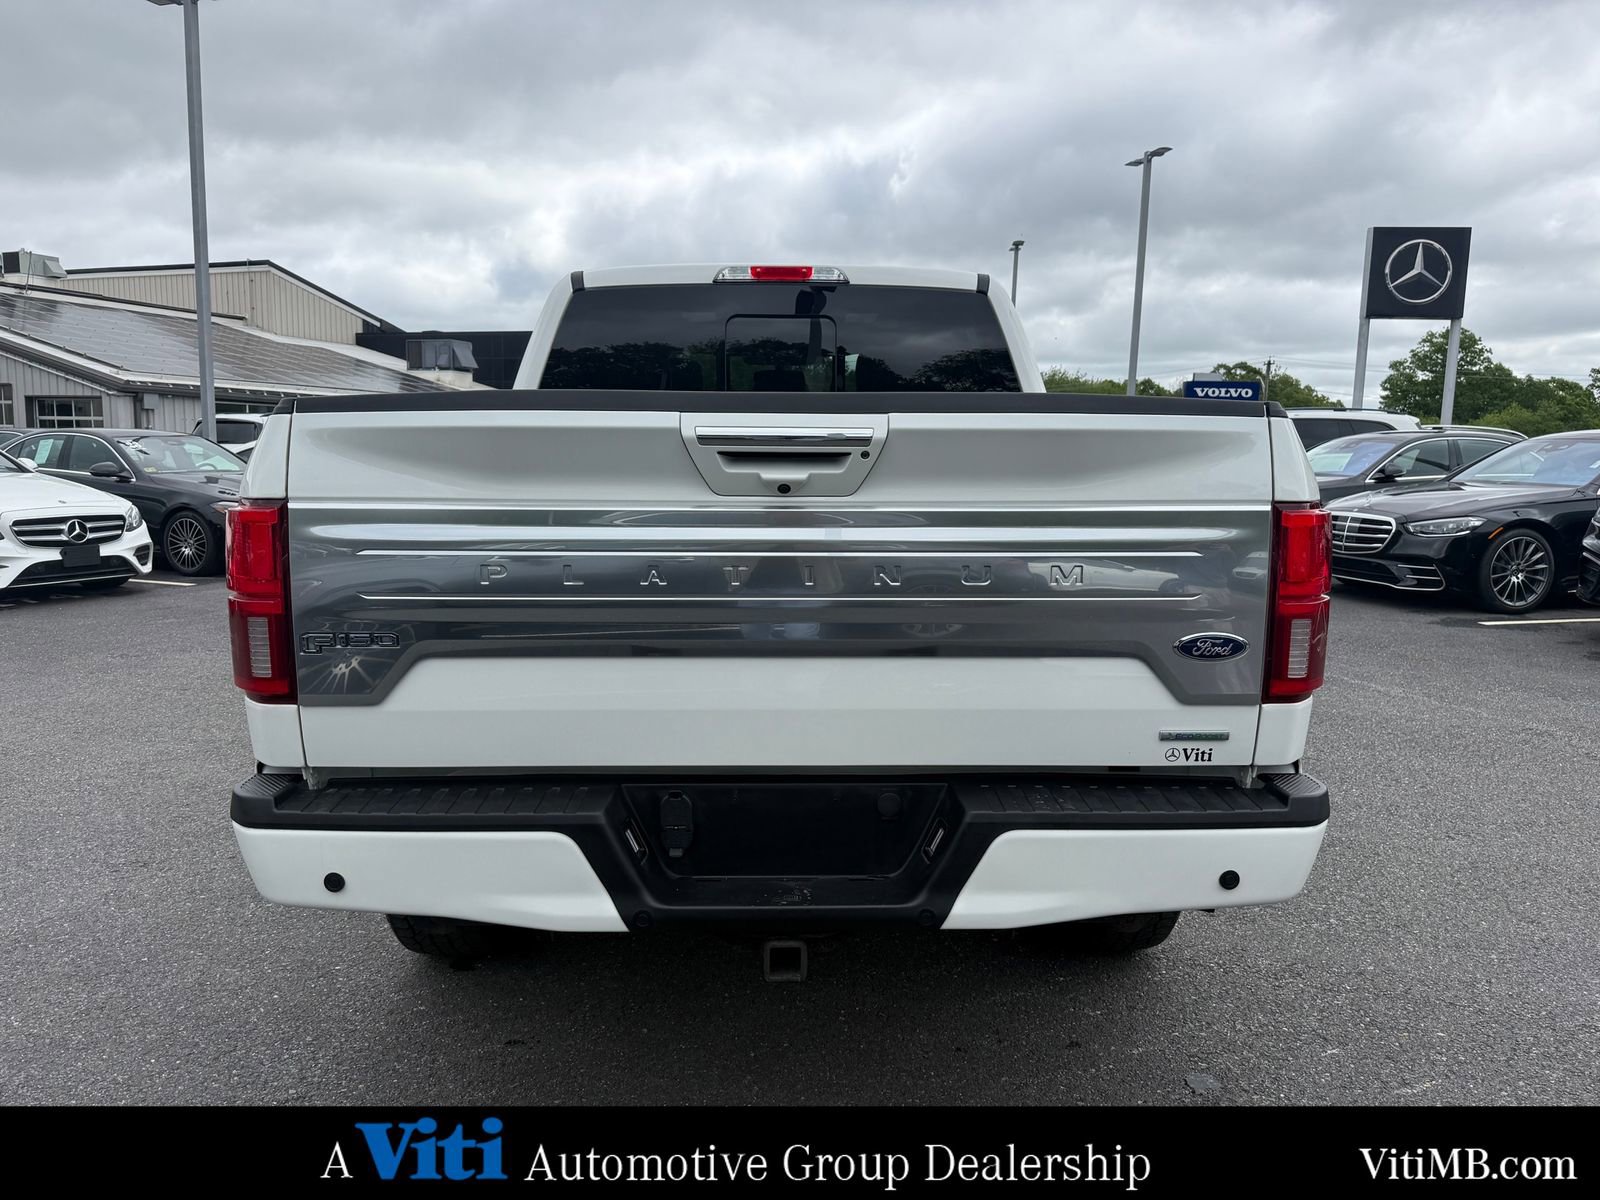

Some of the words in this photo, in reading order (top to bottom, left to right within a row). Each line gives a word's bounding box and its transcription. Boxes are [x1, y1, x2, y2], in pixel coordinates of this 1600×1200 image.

[1193, 387, 1253, 398] VOLVO
[479, 565, 1084, 586] PLATINUM
[1192, 639, 1233, 656] Ford
[1182, 747, 1213, 762] Viti
